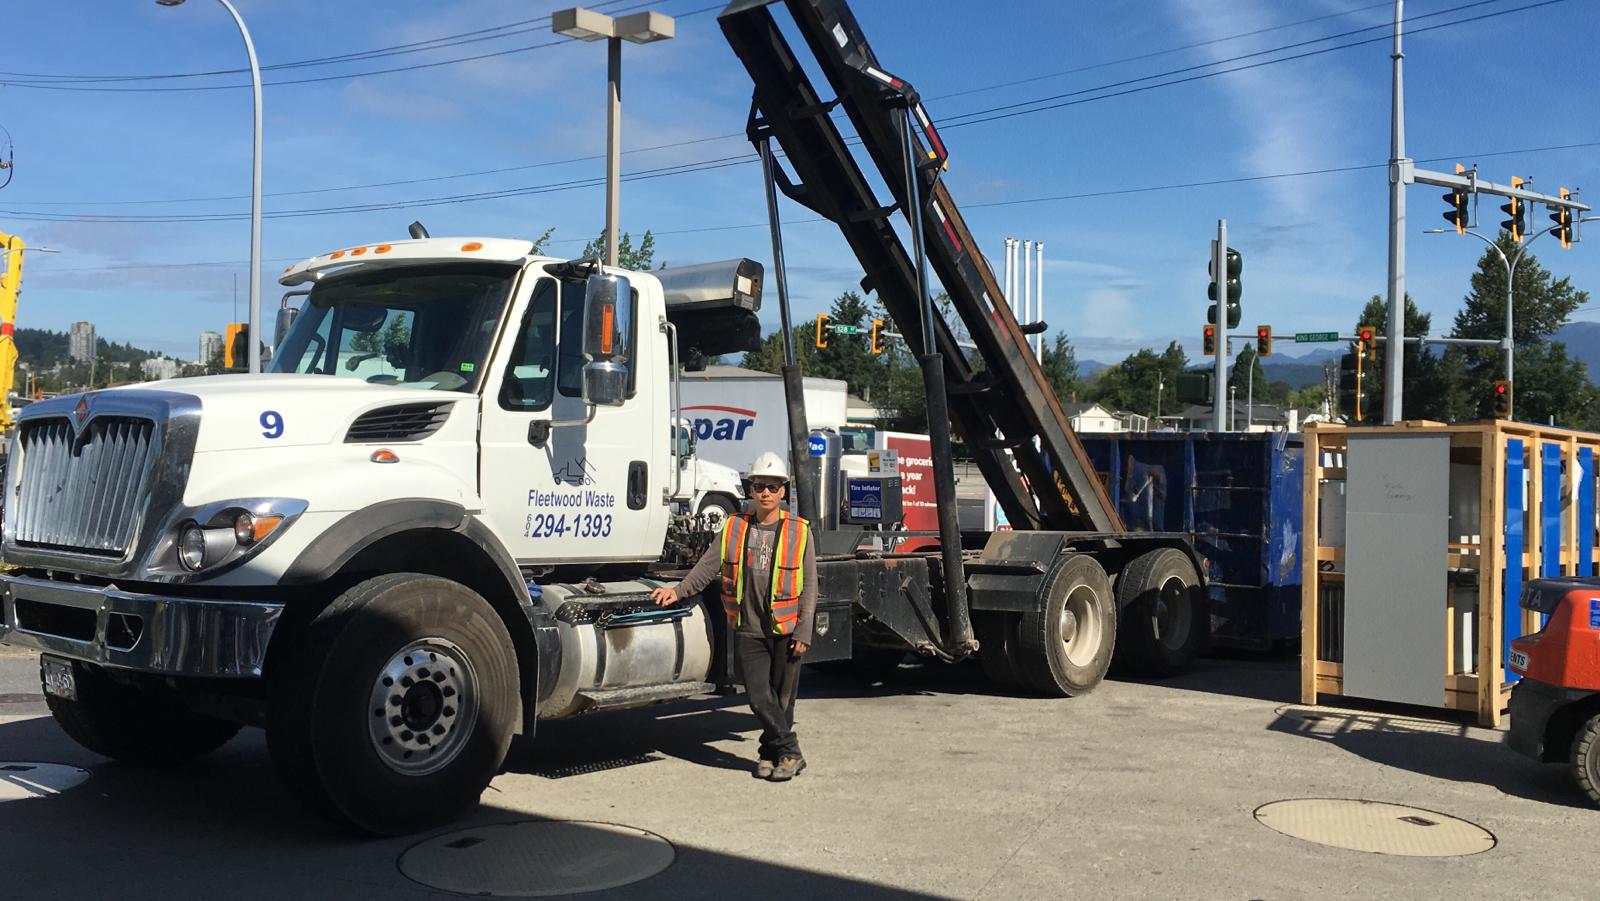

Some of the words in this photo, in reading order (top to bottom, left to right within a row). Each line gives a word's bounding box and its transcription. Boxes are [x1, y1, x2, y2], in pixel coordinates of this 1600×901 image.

[259, 410, 284, 439] 9
[690, 417, 754, 441] par
[905, 457, 933, 468] groceri
[906, 472, 922, 482] year
[528, 489, 582, 507] Fleetwood
[585, 490, 615, 507] Waste
[532, 513, 612, 538] 294-1393
